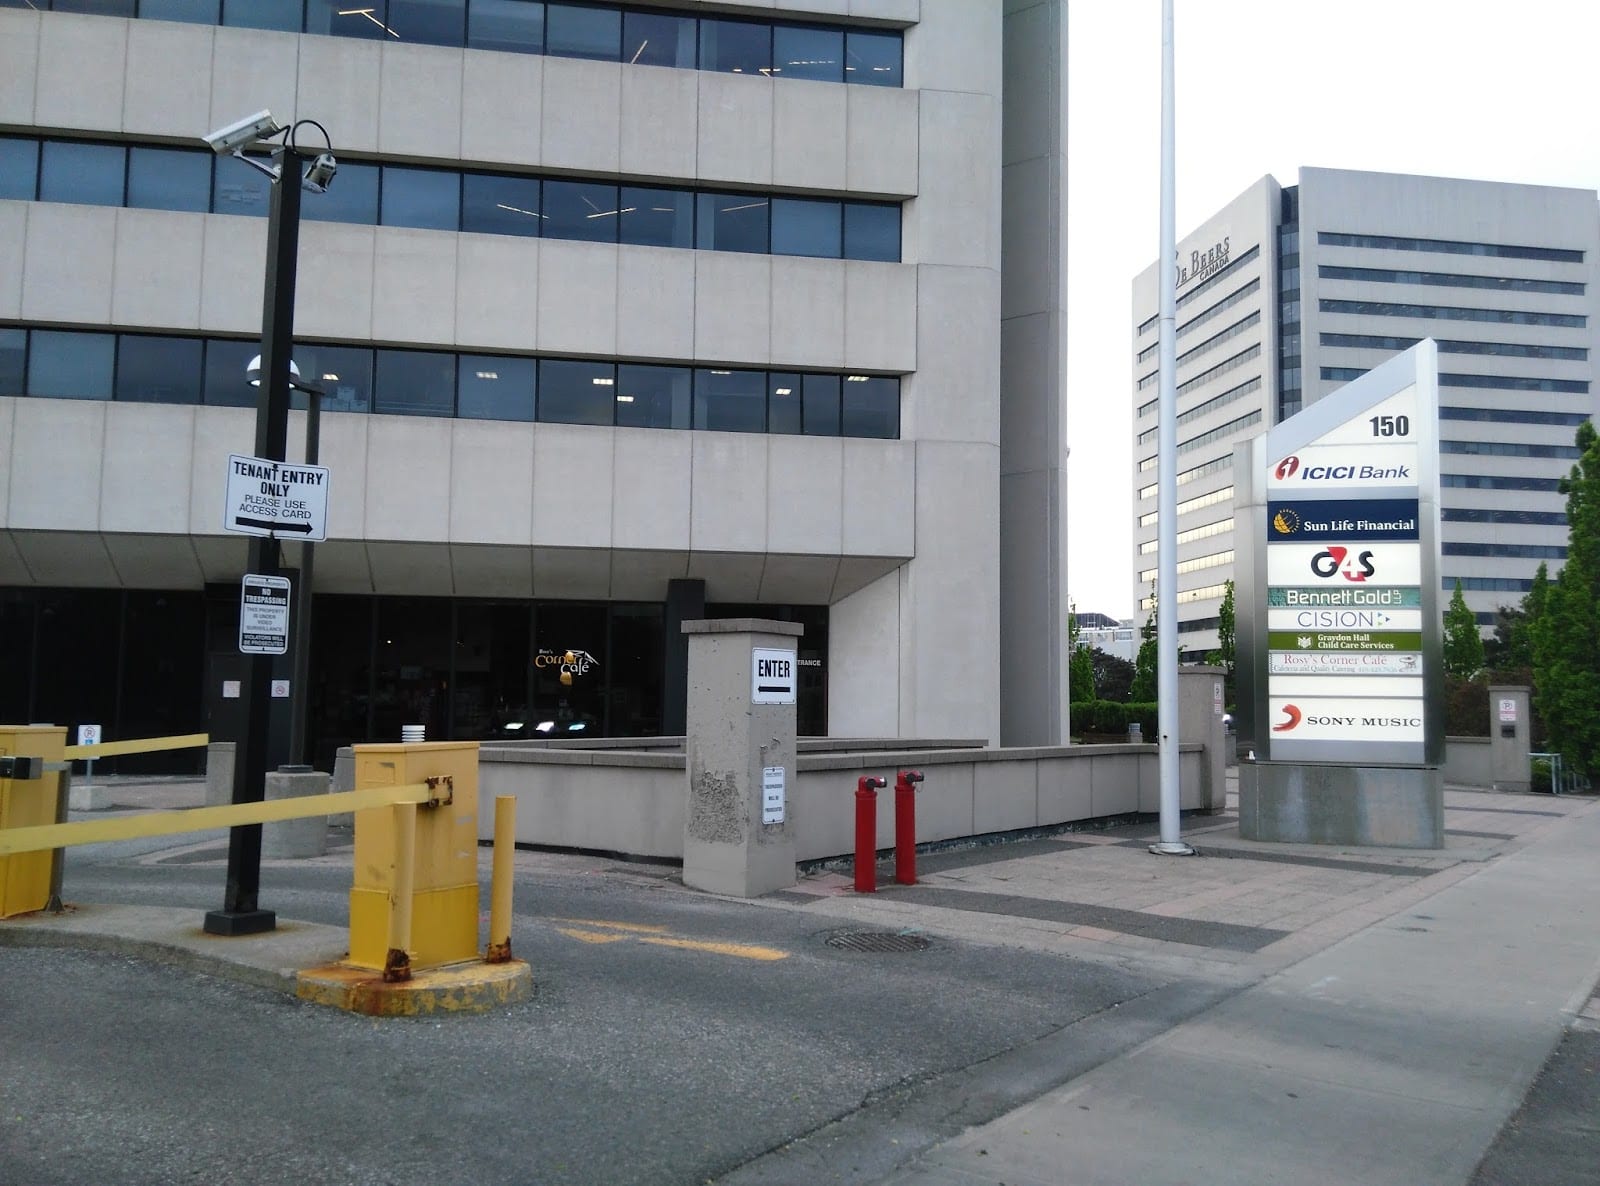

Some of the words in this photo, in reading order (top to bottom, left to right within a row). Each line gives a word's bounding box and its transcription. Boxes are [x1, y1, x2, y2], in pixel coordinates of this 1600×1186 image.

[1199, 255, 1229, 281] CANADA
[1369, 415, 1409, 437] 150
[234, 461, 279, 482] TENANT
[281, 470, 323, 486] ENTRY
[1302, 466, 1355, 480] ICICI
[1359, 465, 1409, 479] Bank
[260, 481, 290, 497] ONLY
[245, 494, 280, 508] PLEASE
[284, 500, 307, 509] USE
[239, 503, 278, 517] ACCESS
[281, 509, 312, 519] CARD
[1304, 520, 1328, 531] Sun
[1331, 520, 1354, 531] Life
[1357, 519, 1414, 531] Financial
[1310, 546, 1375, 582] G4S
[245, 594, 287, 605] TRESPASSING
[261, 588, 272, 596] NO
[1287, 589, 1352, 605] Bennett
[1353, 589, 1391, 605] Gold
[1297, 611, 1373, 627] CISION
[1317, 633, 1352, 642] Graydon
[1353, 633, 1370, 641] Hall
[1317, 641, 1339, 649] Child
[1284, 653, 1317, 666] Rosy's
[1320, 653, 1358, 665] Corner
[1362, 653, 1387, 665] Café
[758, 658, 790, 678] ENTER
[1307, 716, 1356, 726] SONY
[1362, 717, 1421, 727] MUSIC
